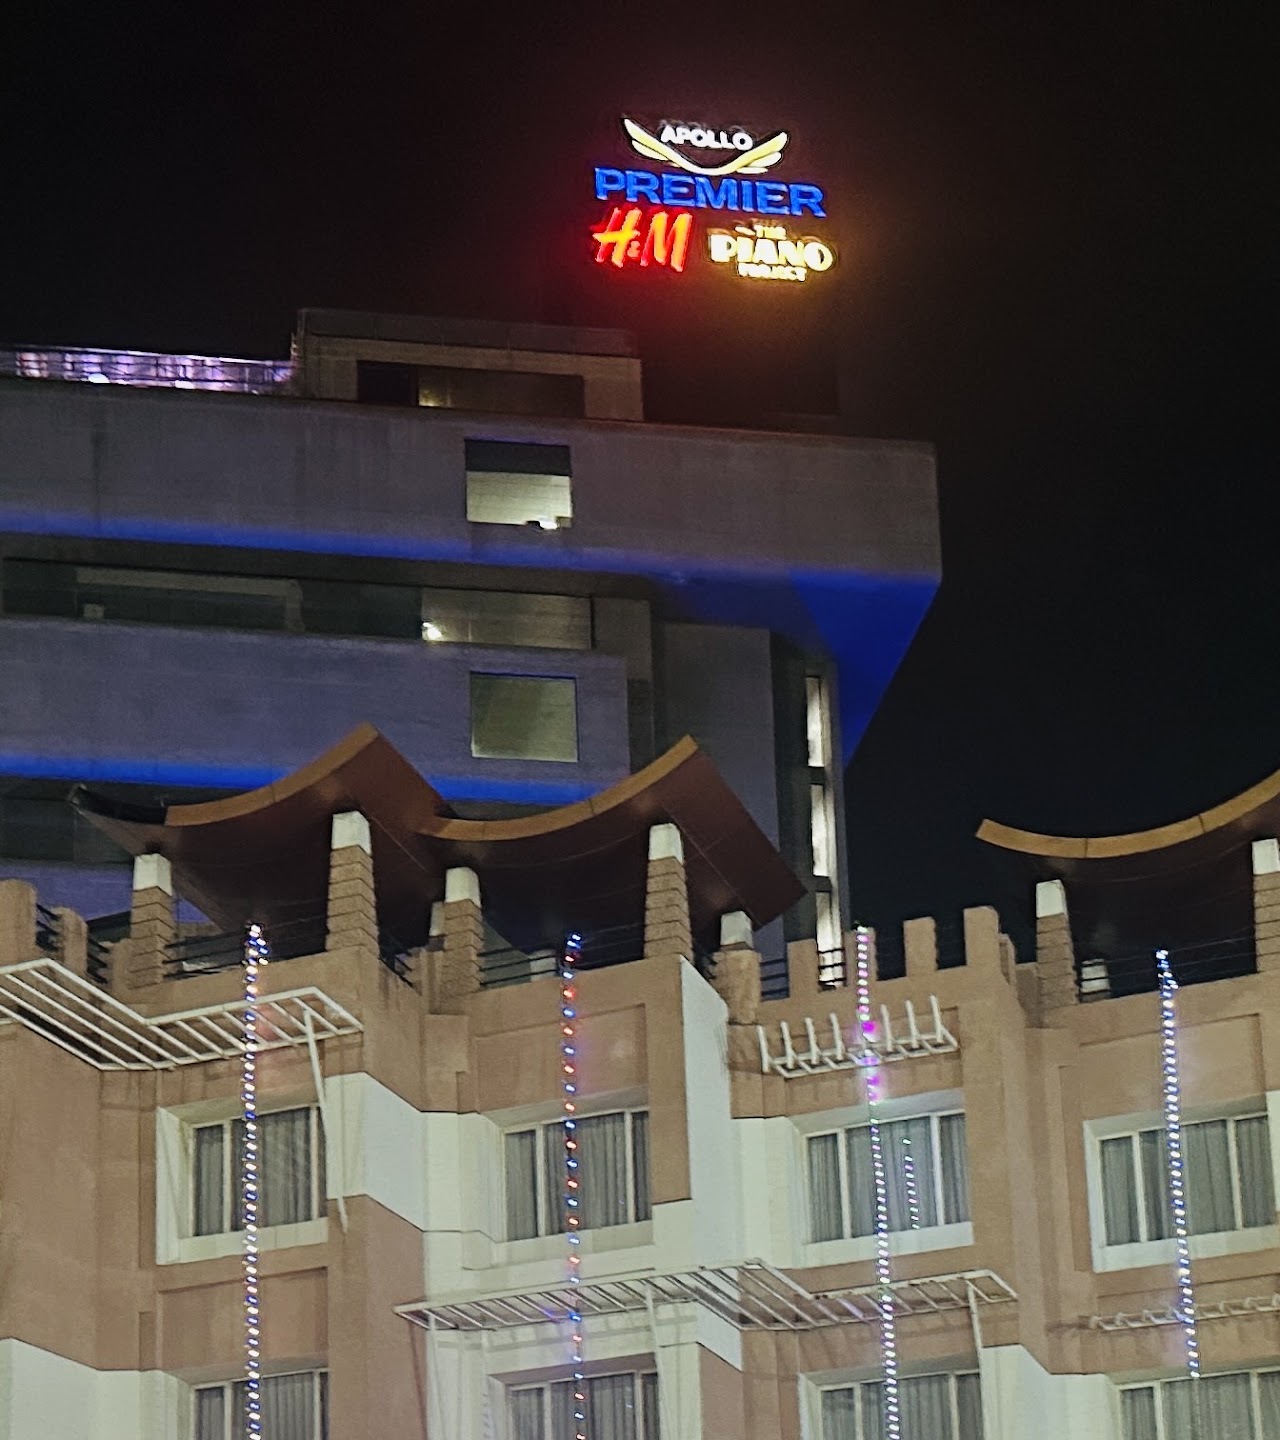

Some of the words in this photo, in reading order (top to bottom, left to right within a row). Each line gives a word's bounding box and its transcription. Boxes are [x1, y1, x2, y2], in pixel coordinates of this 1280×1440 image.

[660, 125, 754, 151] APOLLO
[594, 166, 827, 218] PREMIER
[709, 233, 835, 272] PIANO
